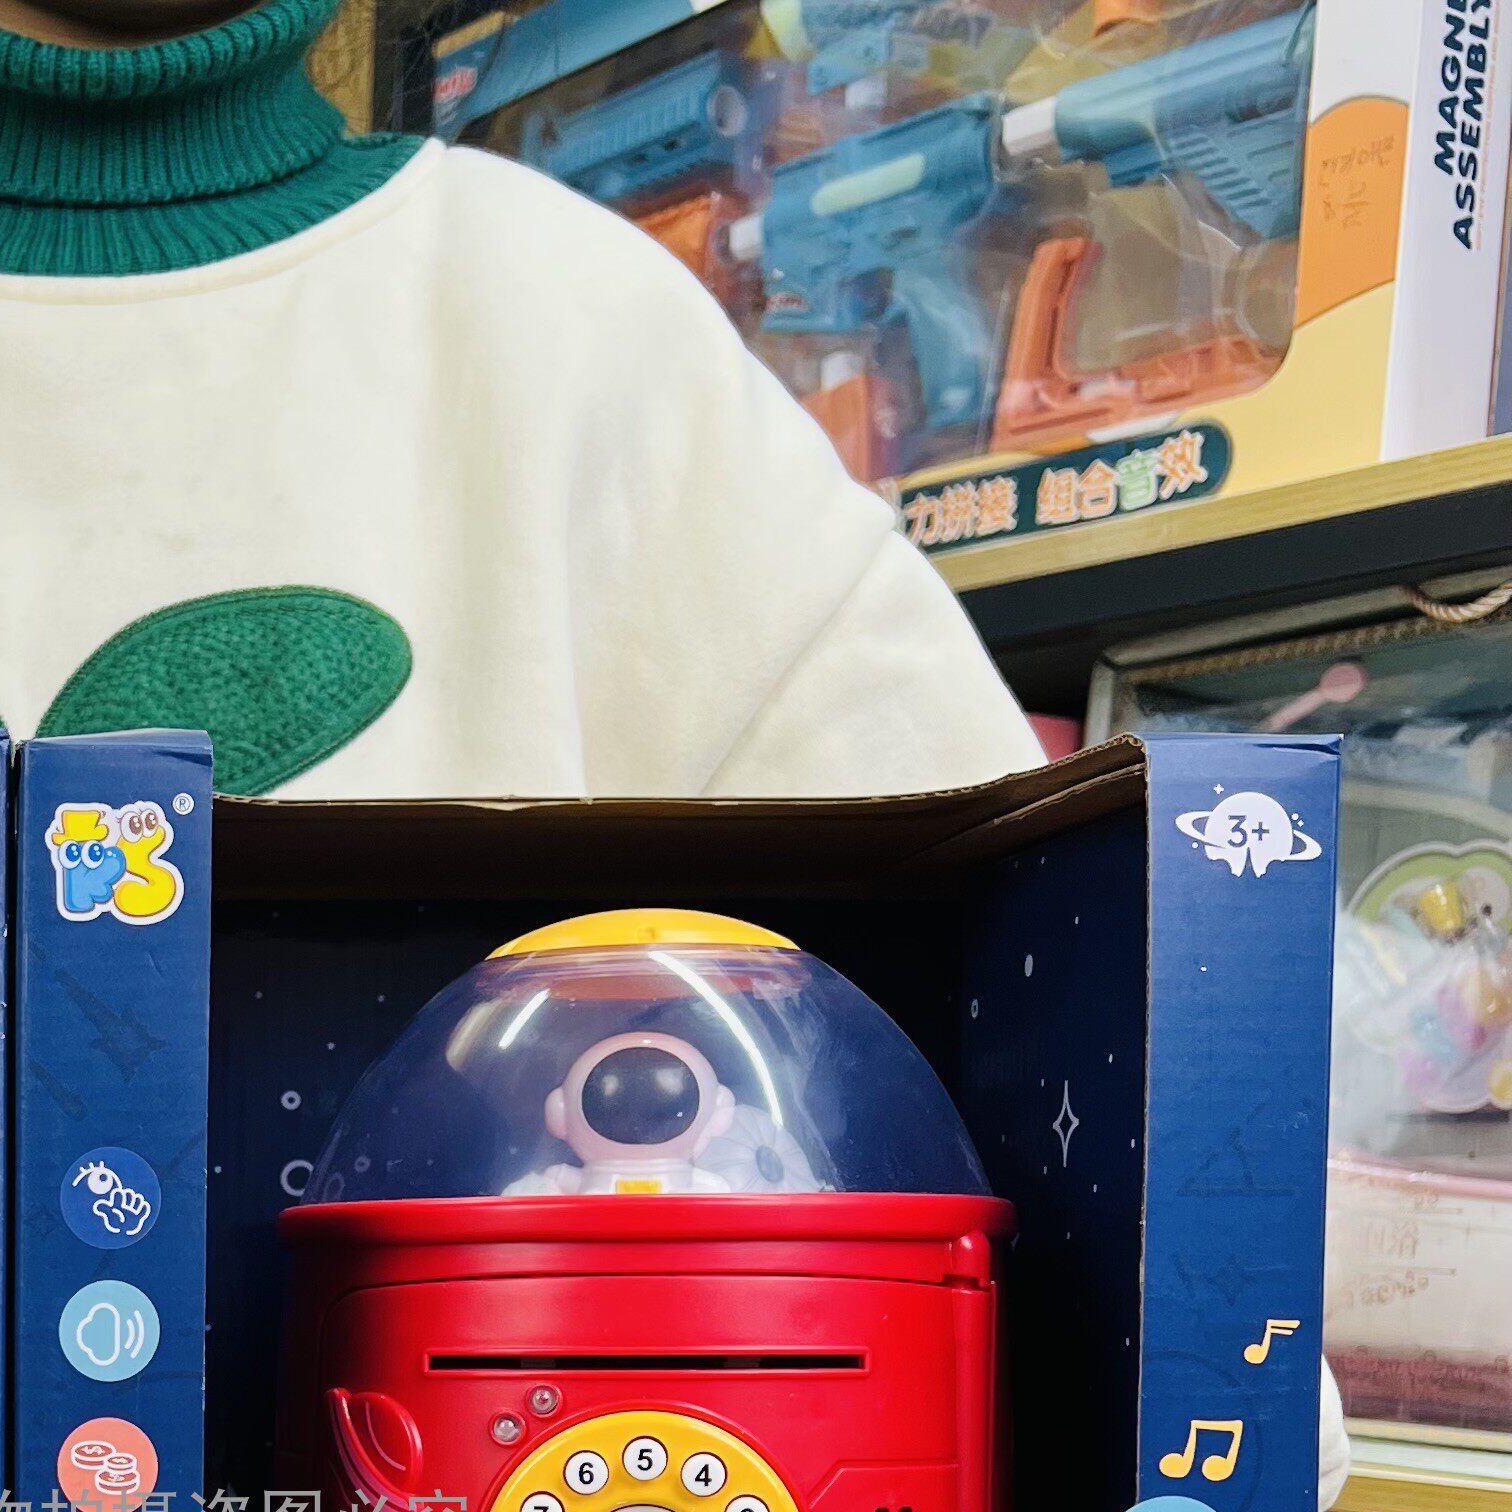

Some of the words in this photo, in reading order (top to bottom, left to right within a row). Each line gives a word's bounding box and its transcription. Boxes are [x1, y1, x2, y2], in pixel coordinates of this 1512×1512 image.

[880, 476, 1019, 547] 力拼接
[1227, 814, 1271, 848] 3+
[637, 1448, 653, 1472] 5
[578, 1461, 595, 1485] 6
[694, 1463, 713, 1487] 4
